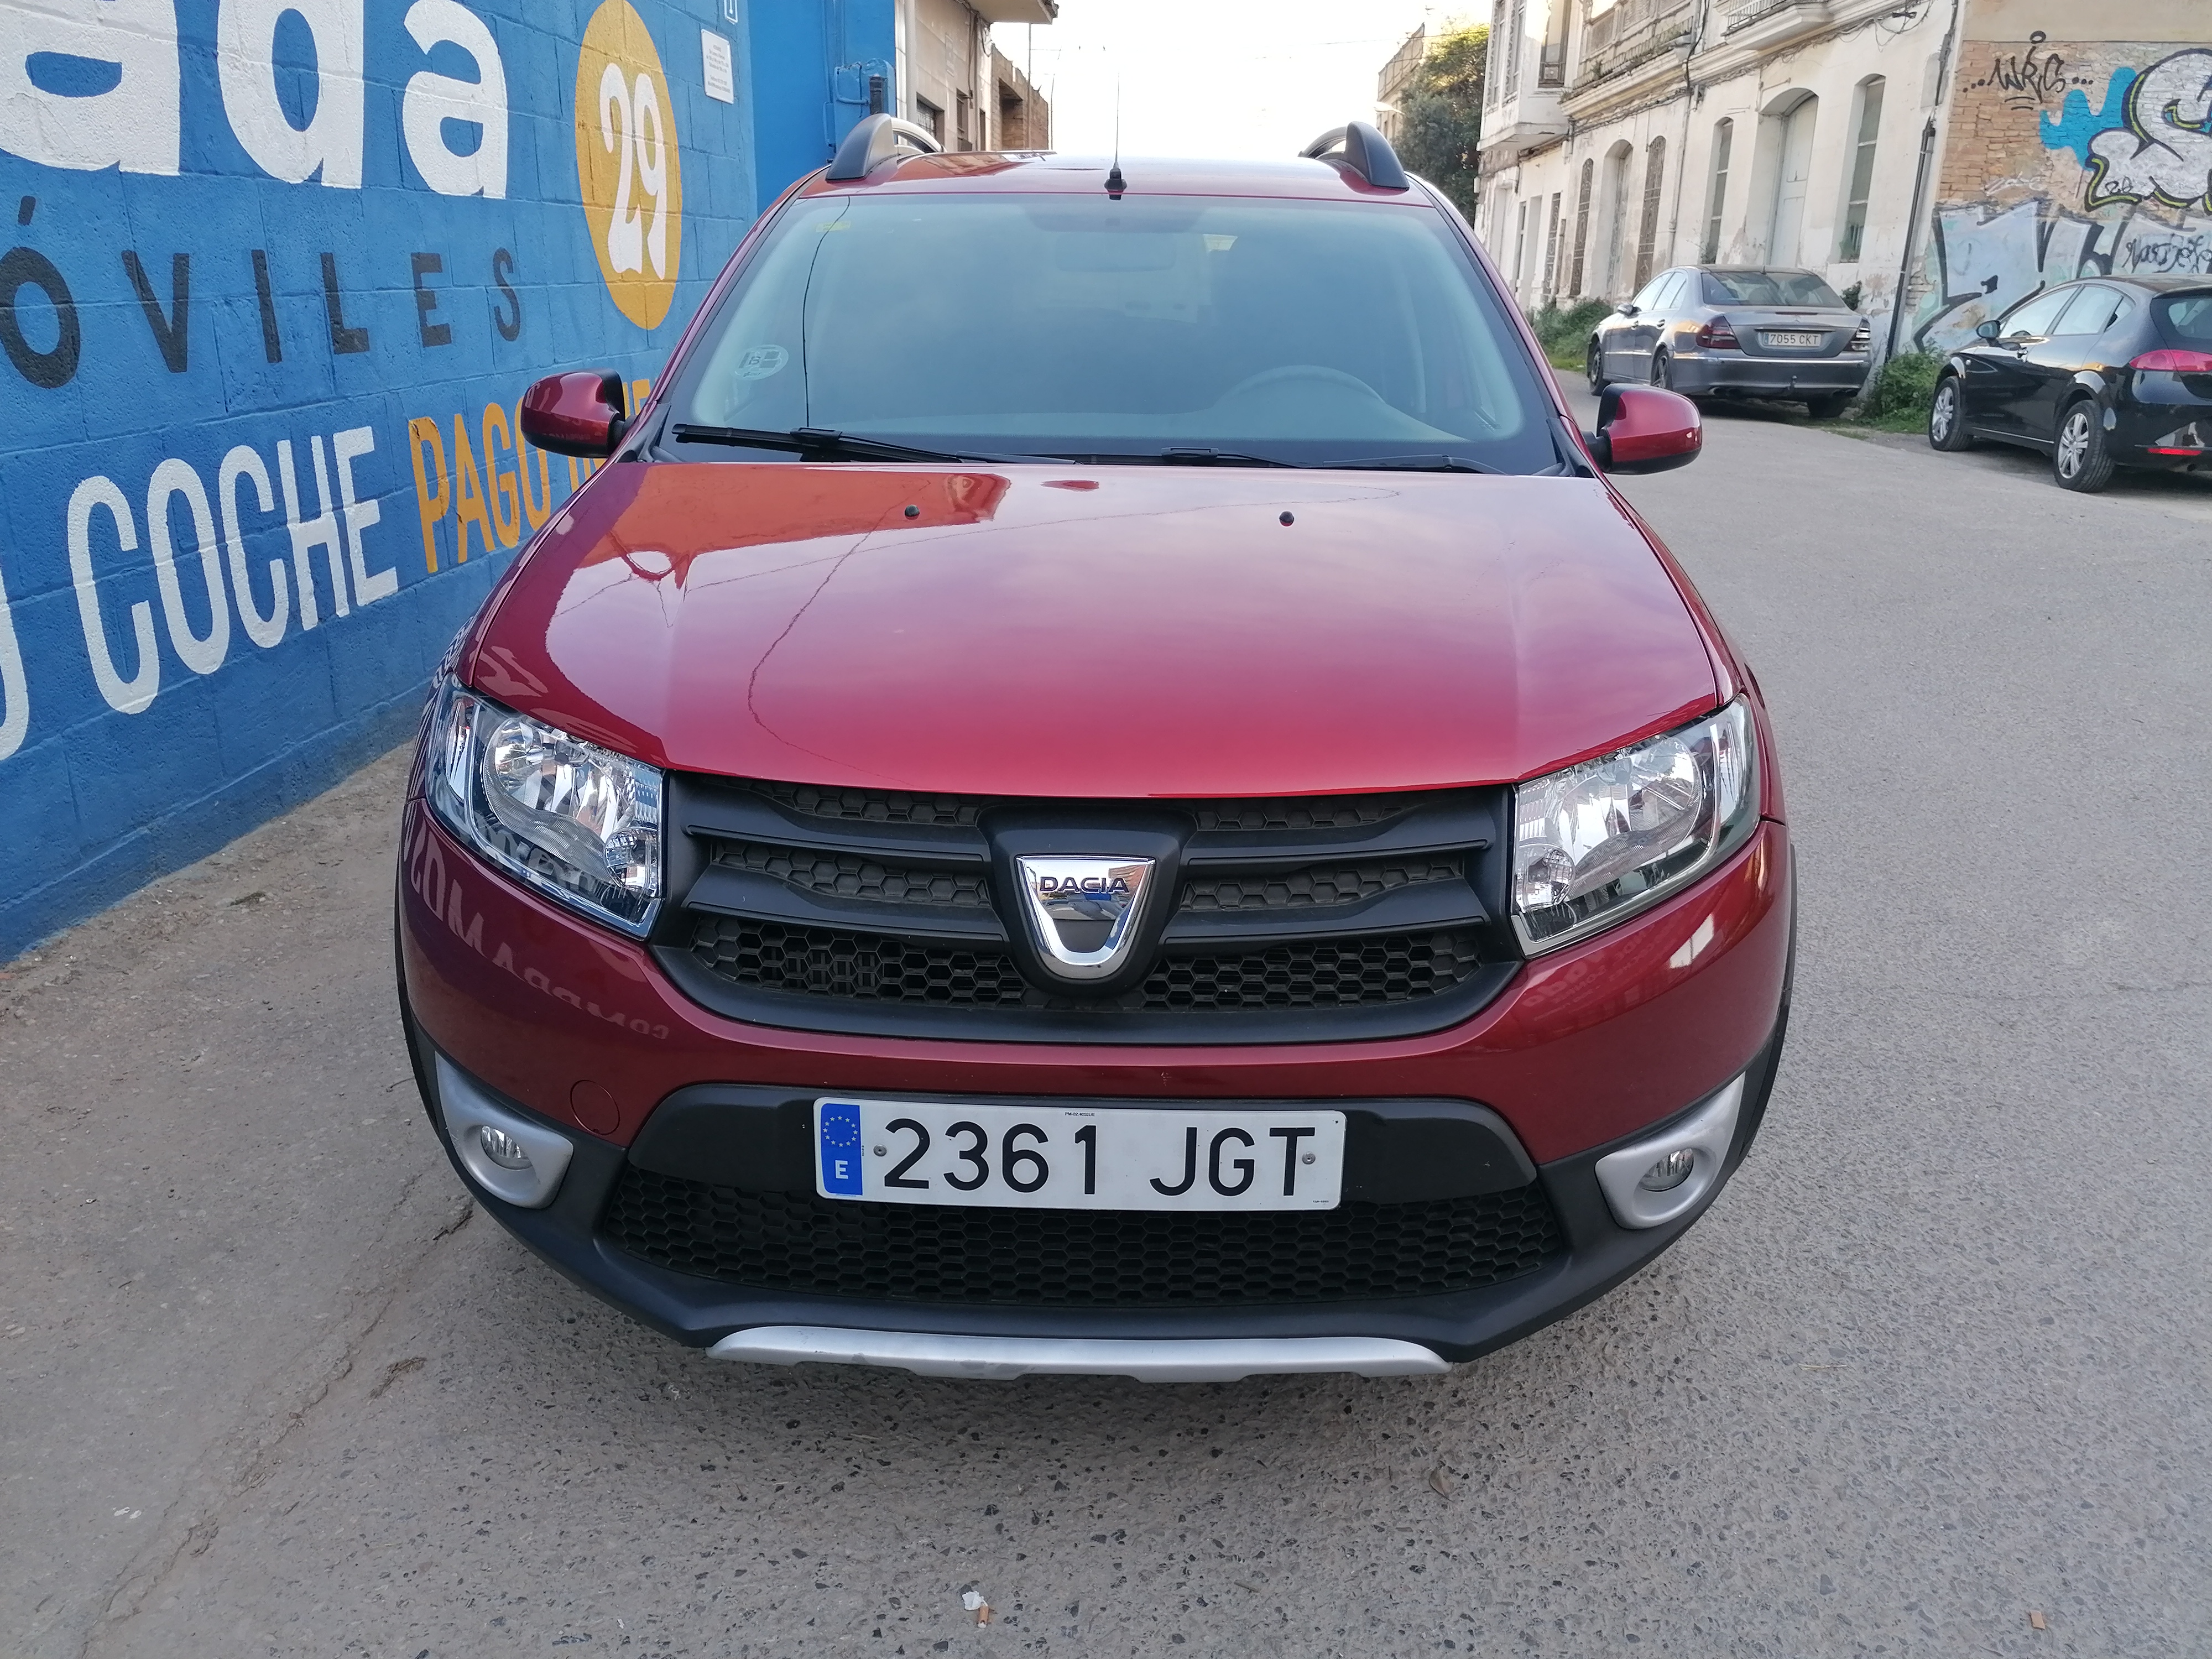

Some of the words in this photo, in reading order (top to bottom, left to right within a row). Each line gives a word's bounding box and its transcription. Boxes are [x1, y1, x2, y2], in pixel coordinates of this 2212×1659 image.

[599, 62, 667, 280] 29
[1770, 334, 1796, 343] 7055
[1799, 335, 1818, 344] CKT
[67, 426, 398, 714] COCHE
[1039, 876, 1130, 894] DACIA
[835, 1160, 849, 1180] E
[884, 1118, 1096, 1195] 2361
[1150, 1127, 1315, 1196] JGT
